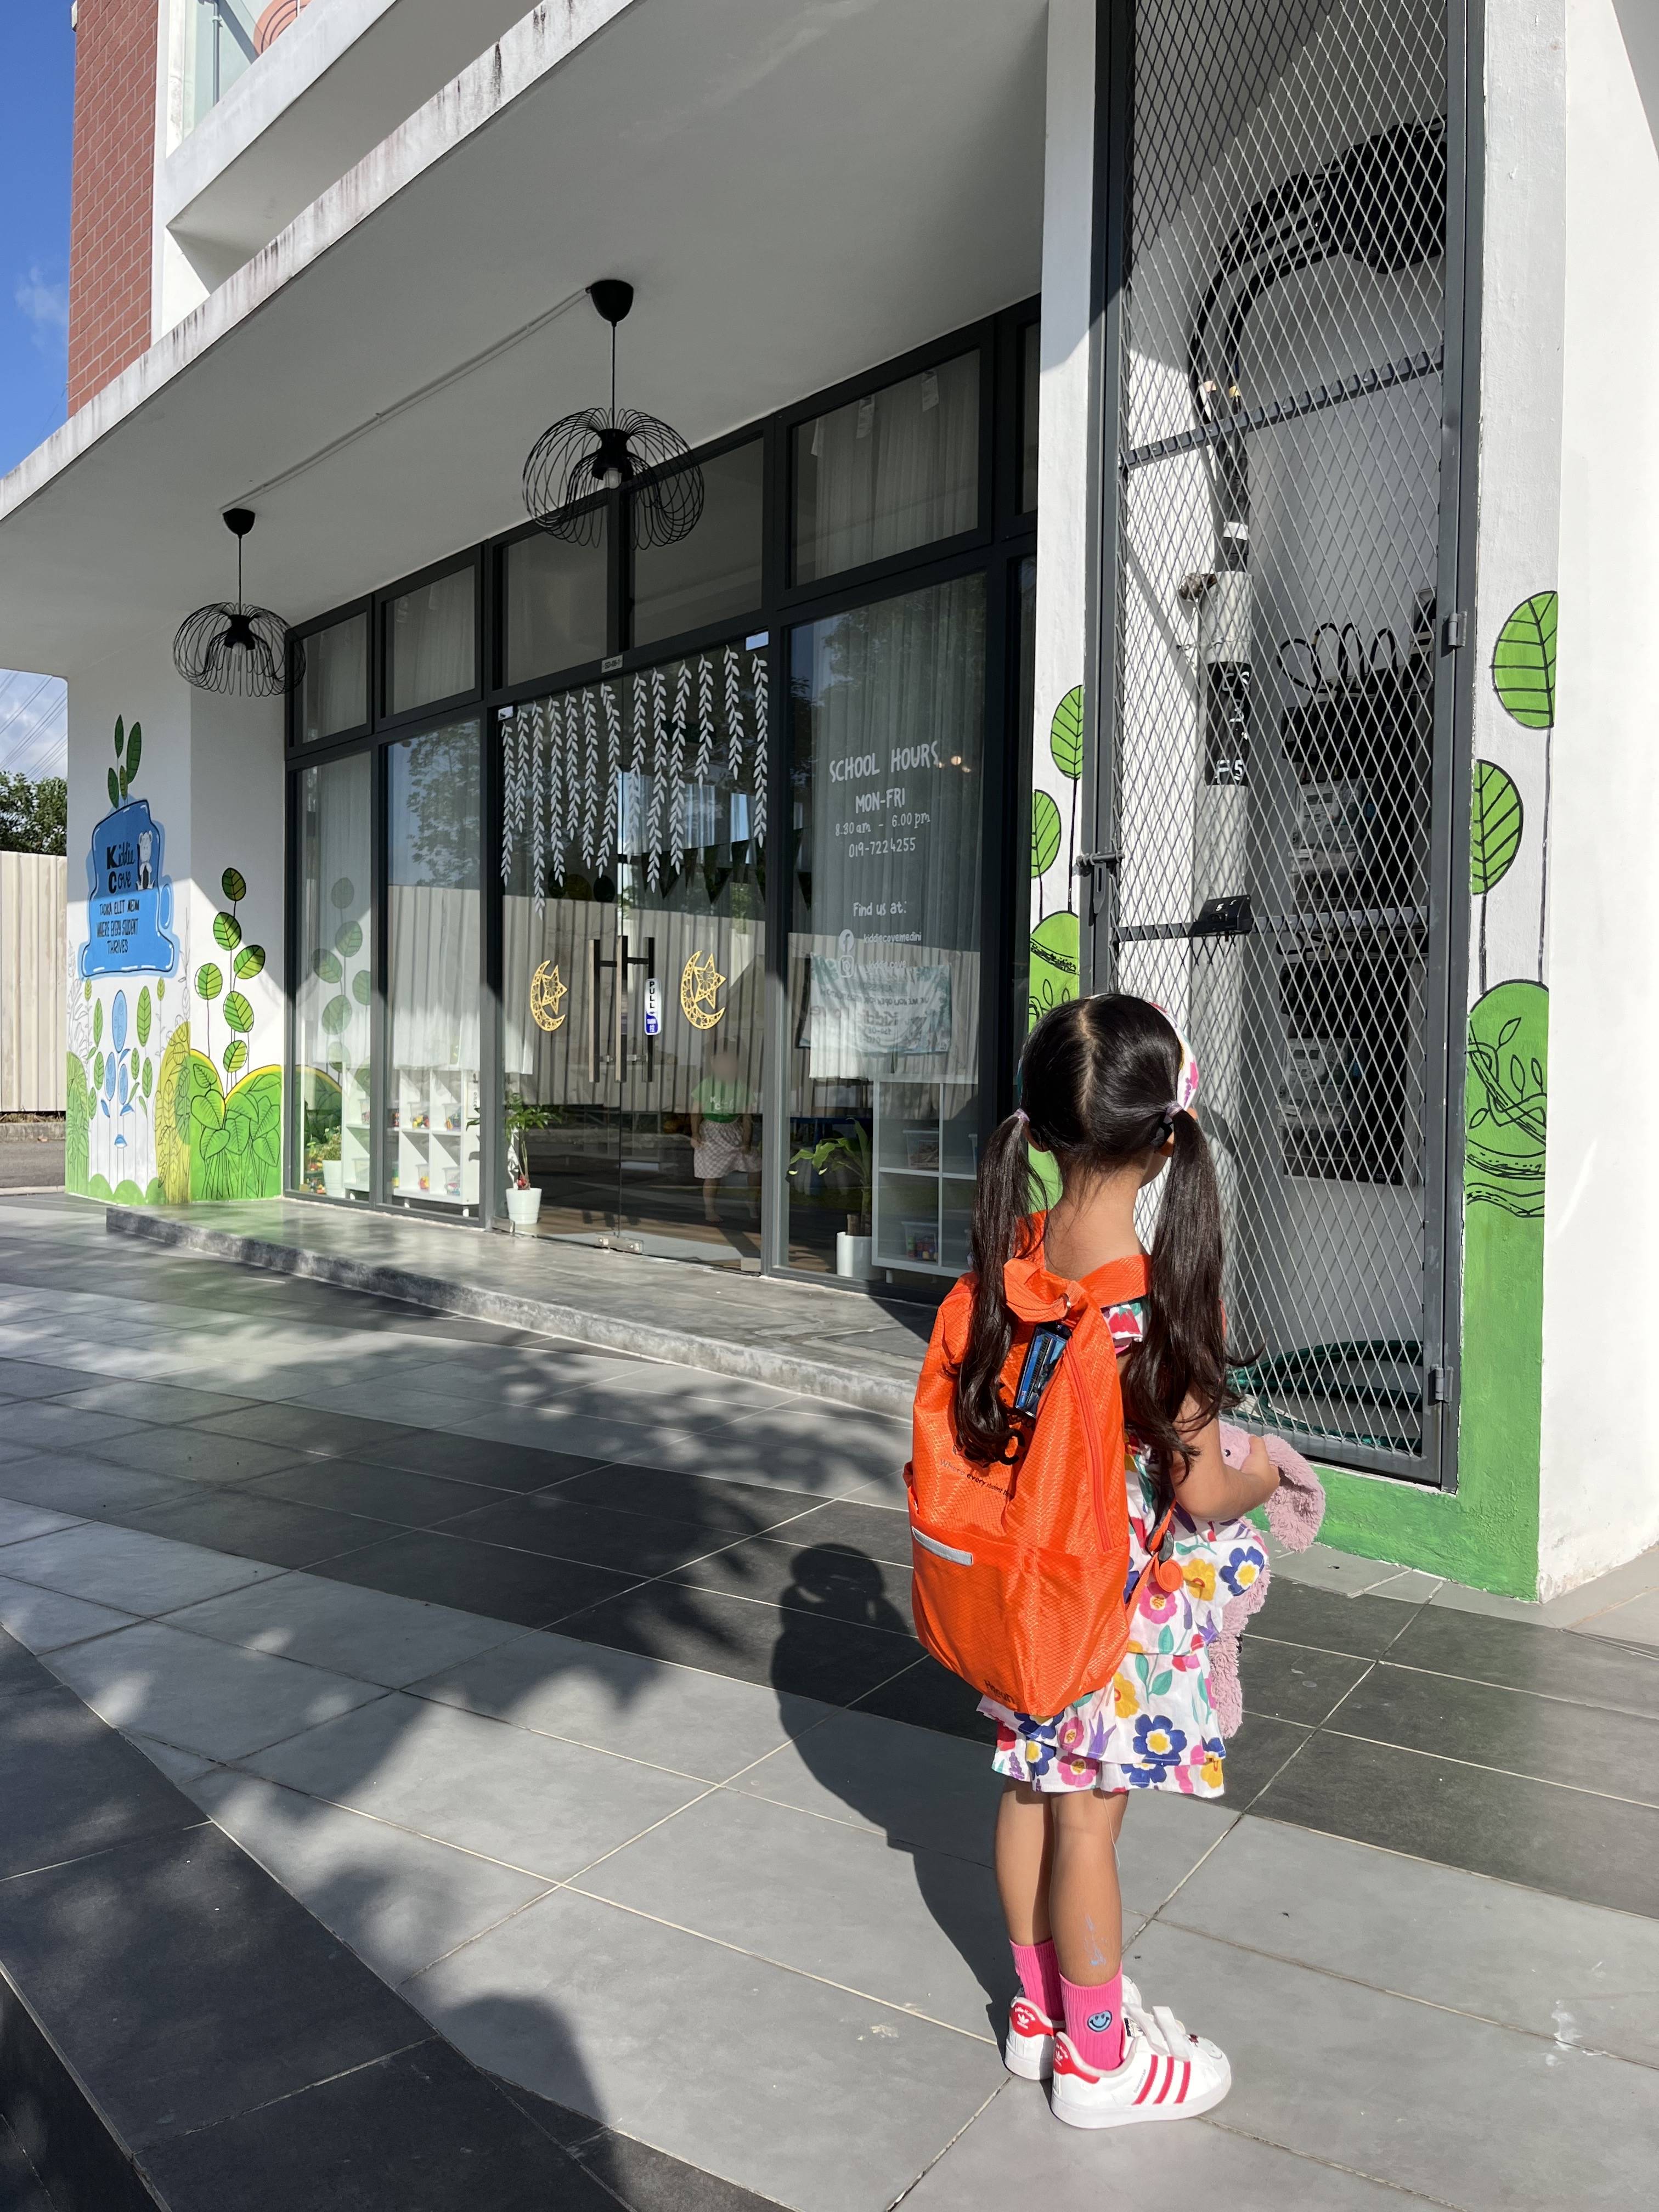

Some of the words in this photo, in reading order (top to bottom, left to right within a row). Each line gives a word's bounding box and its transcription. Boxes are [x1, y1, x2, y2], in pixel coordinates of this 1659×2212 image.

[829, 753, 880, 783] SCHOOL
[890, 741, 939, 772] HOURS
[855, 788, 905, 814] MON-FRI
[106, 842, 135, 870] Kiddie
[108, 871, 131, 894] Cove
[114, 900, 125, 915] ELIT
[853, 902, 873, 917] Find
[876, 903, 886, 916] us
[890, 901, 907, 914] at:
[107, 939, 128, 954] THRIVES
[940, 1458, 965, 1476] Where
[967, 1474, 986, 1487] every
